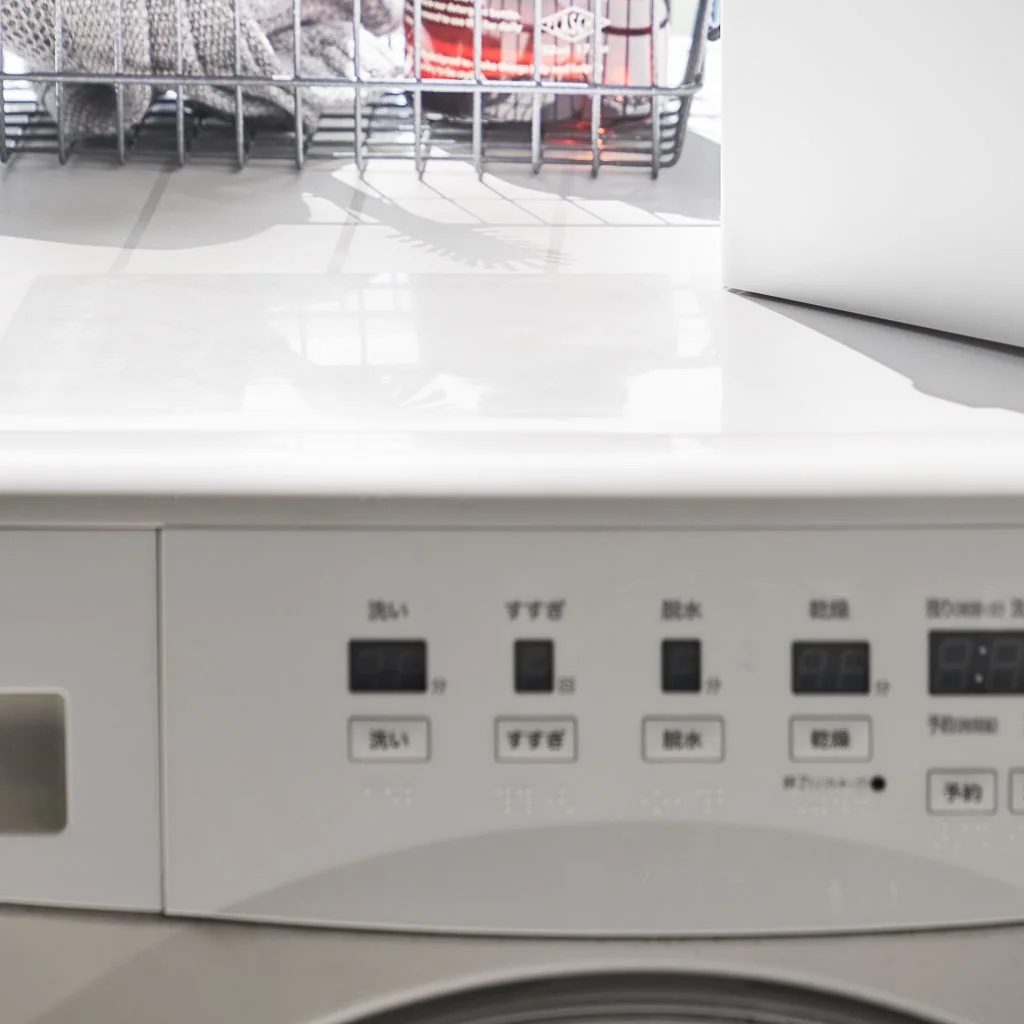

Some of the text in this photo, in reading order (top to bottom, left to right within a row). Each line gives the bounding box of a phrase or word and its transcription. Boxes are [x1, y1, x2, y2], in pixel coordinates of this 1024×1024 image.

[368, 600, 409, 621] 洗い
[506, 599, 566, 621] すすぎ
[661, 599, 702, 621] 脱水
[369, 729, 409, 749] 洗い
[507, 729, 565, 750] すすぎ
[662, 728, 702, 750] 脱水
[944, 782, 982, 802] 予約
